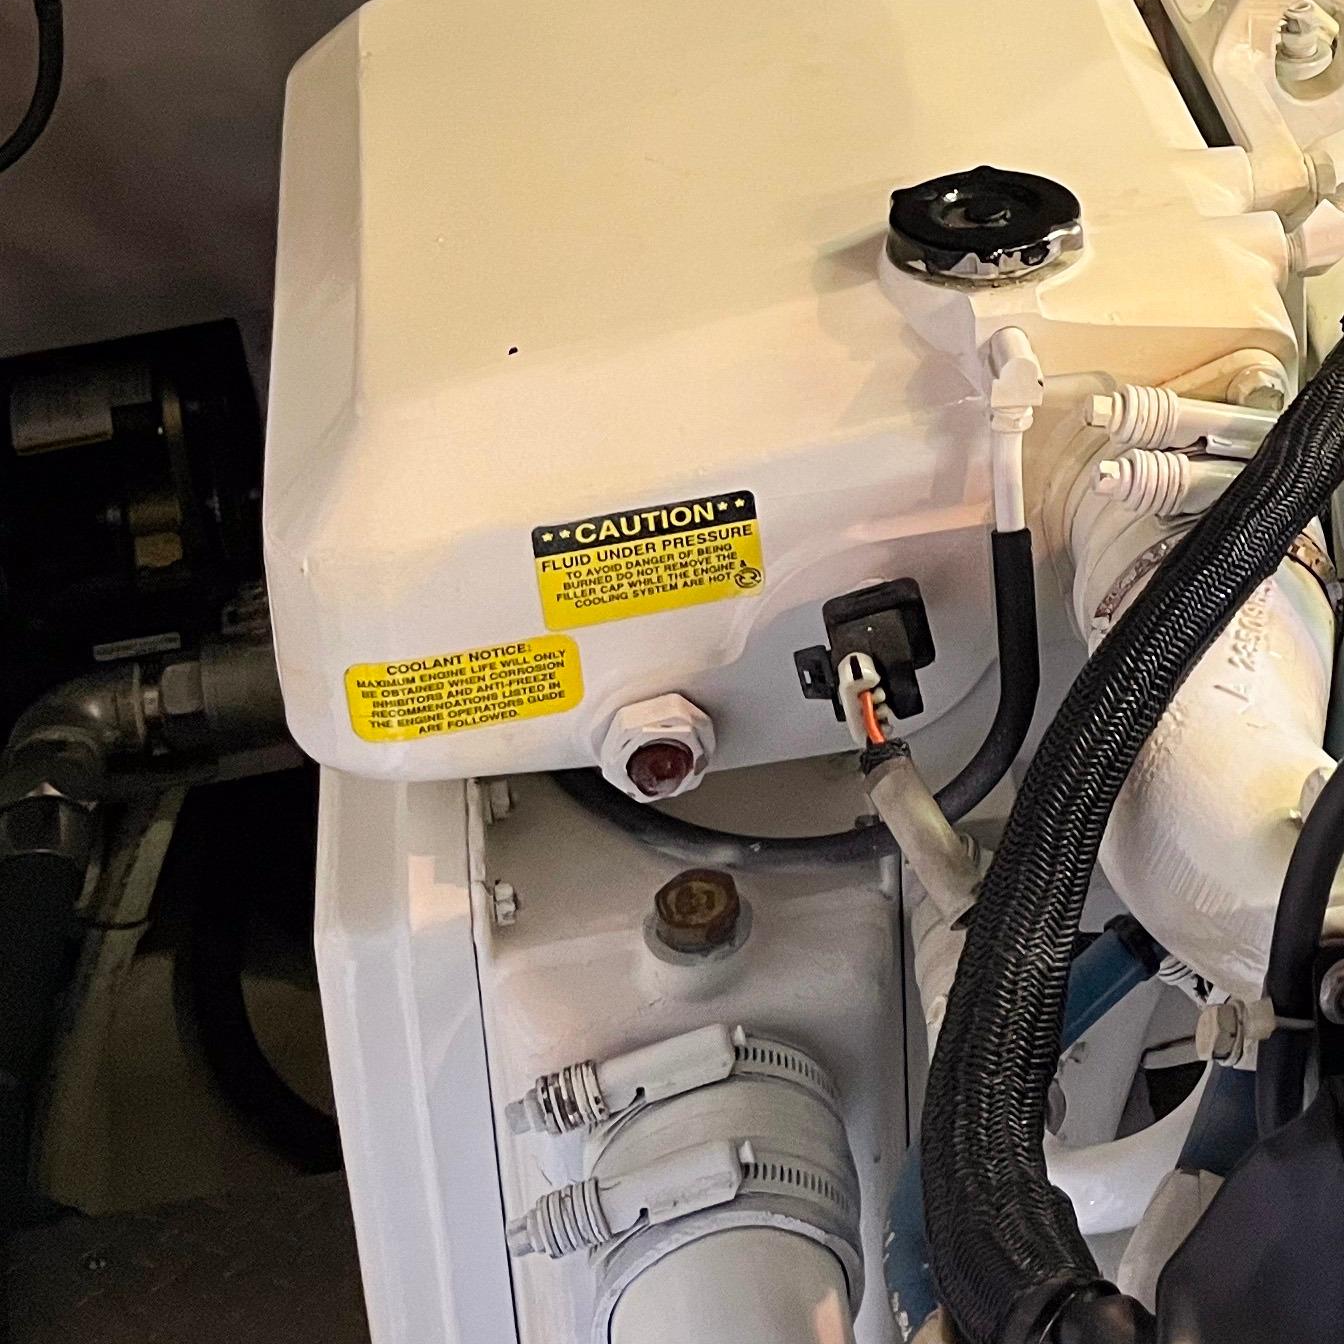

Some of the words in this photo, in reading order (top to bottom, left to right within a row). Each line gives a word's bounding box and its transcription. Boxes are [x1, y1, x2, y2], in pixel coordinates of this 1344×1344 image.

[574, 502, 715, 544] CAUTION
[541, 553, 591, 573] FLUID
[597, 542, 657, 563] UNDER
[662, 524, 753, 551] PRESSURE
[566, 569, 582, 581] TO
[586, 563, 623, 578] AVOID
[626, 553, 675, 571] DANGER
[679, 550, 694, 561] OF
[697, 543, 732, 557] BEING
[556, 587, 597, 602] FILLER
[600, 582, 624, 594] CAP
[627, 576, 664, 590] WHILE
[668, 570, 690, 583] THE
[693, 561, 736, 577] ENGINE
[563, 574, 613, 591] BURNED
[616, 570, 634, 582] DO
[637, 566, 660, 578] NOT
[664, 556, 713, 573] REMOVE
[715, 551, 738, 563] THE
[575, 592, 629, 609] COOLING
[632, 582, 679, 598] SYSTEM
[682, 576, 705, 589] ARE
[708, 571, 732, 584] HOT
[357, 676, 417, 689] MAXIMUM
[419, 667, 468, 683] ENGINE
[471, 661, 498, 675] LIFE
[500, 656, 530, 668] WILL
[533, 649, 567, 662] ONLY
[361, 690, 378, 699] BE
[381, 681, 445, 699] OBTAINED
[448, 674, 487, 688] WHEN
[490, 659, 566, 681] CORROSION
[386, 654, 464, 676] COOLANT
[368, 718, 393, 729] THE
[397, 712, 444, 728] ENGINE
[447, 697, 525, 719] OPERATORS
[527, 690, 567, 705] GUIDE
[371, 695, 499, 720] RECOMMENDATIONS
[502, 684, 546, 699] LISTED
[372, 692, 444, 709] INHIBITORS
[447, 687, 473, 699] AND
[476, 671, 557, 694] ANTI-FREEZE
[418, 722, 444, 735] ARE
